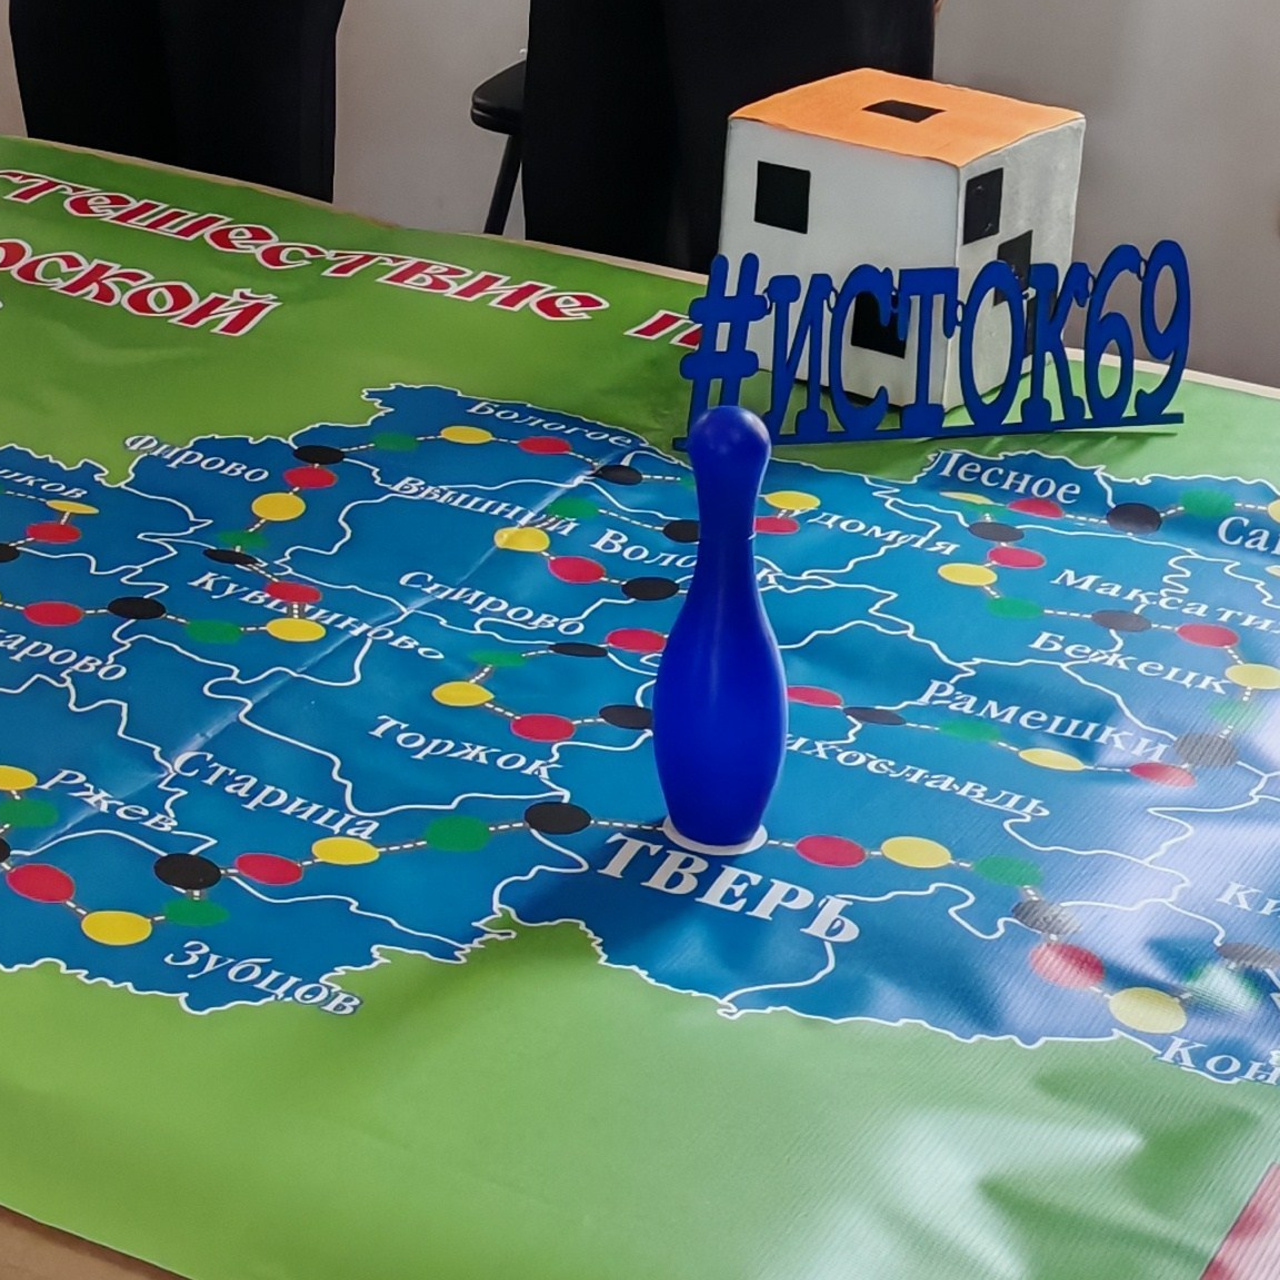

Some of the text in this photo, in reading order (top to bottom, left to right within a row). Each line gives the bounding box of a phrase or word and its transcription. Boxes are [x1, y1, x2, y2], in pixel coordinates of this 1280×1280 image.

[679, 239, 1191, 448] #ИСТОК69
[466, 401, 632, 447] Бологое
[124, 434, 270, 483] Фирово
[937, 450, 1081, 505] Лесное
[390, 476, 579, 538] Вышний
[399, 570, 586, 637] Спирово
[1028, 631, 1234, 695] Бежецк
[368, 714, 564, 780] Торжок
[917, 678, 1179, 763] Рамешки
[34, 768, 179, 834] Ржев
[172, 749, 381, 840] Старица
[786, 732, 1051, 817] ихославль
[597, 832, 861, 944] ТВЕРЬ
[163, 940, 362, 1016] Зубцов
